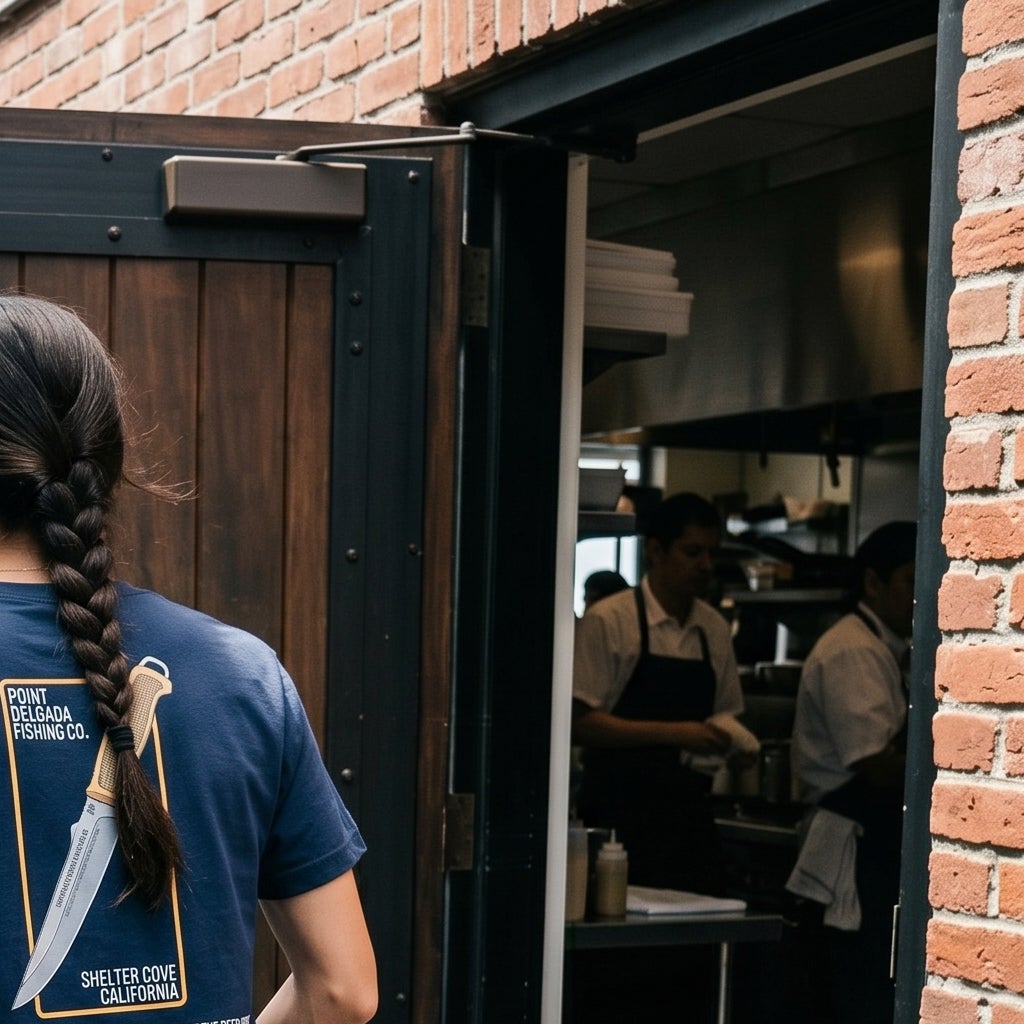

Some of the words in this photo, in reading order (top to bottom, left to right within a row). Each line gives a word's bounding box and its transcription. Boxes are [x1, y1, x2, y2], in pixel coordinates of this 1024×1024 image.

[7, 687, 47, 705] POINT
[10, 705, 72, 723] DELGADA
[13, 723, 64, 741] FISHING
[66, 723, 90, 740] CO.
[80, 967, 140, 988] SHELTER
[142, 964, 177, 984] COVE
[100, 982, 180, 1005] CALIFORNIA
